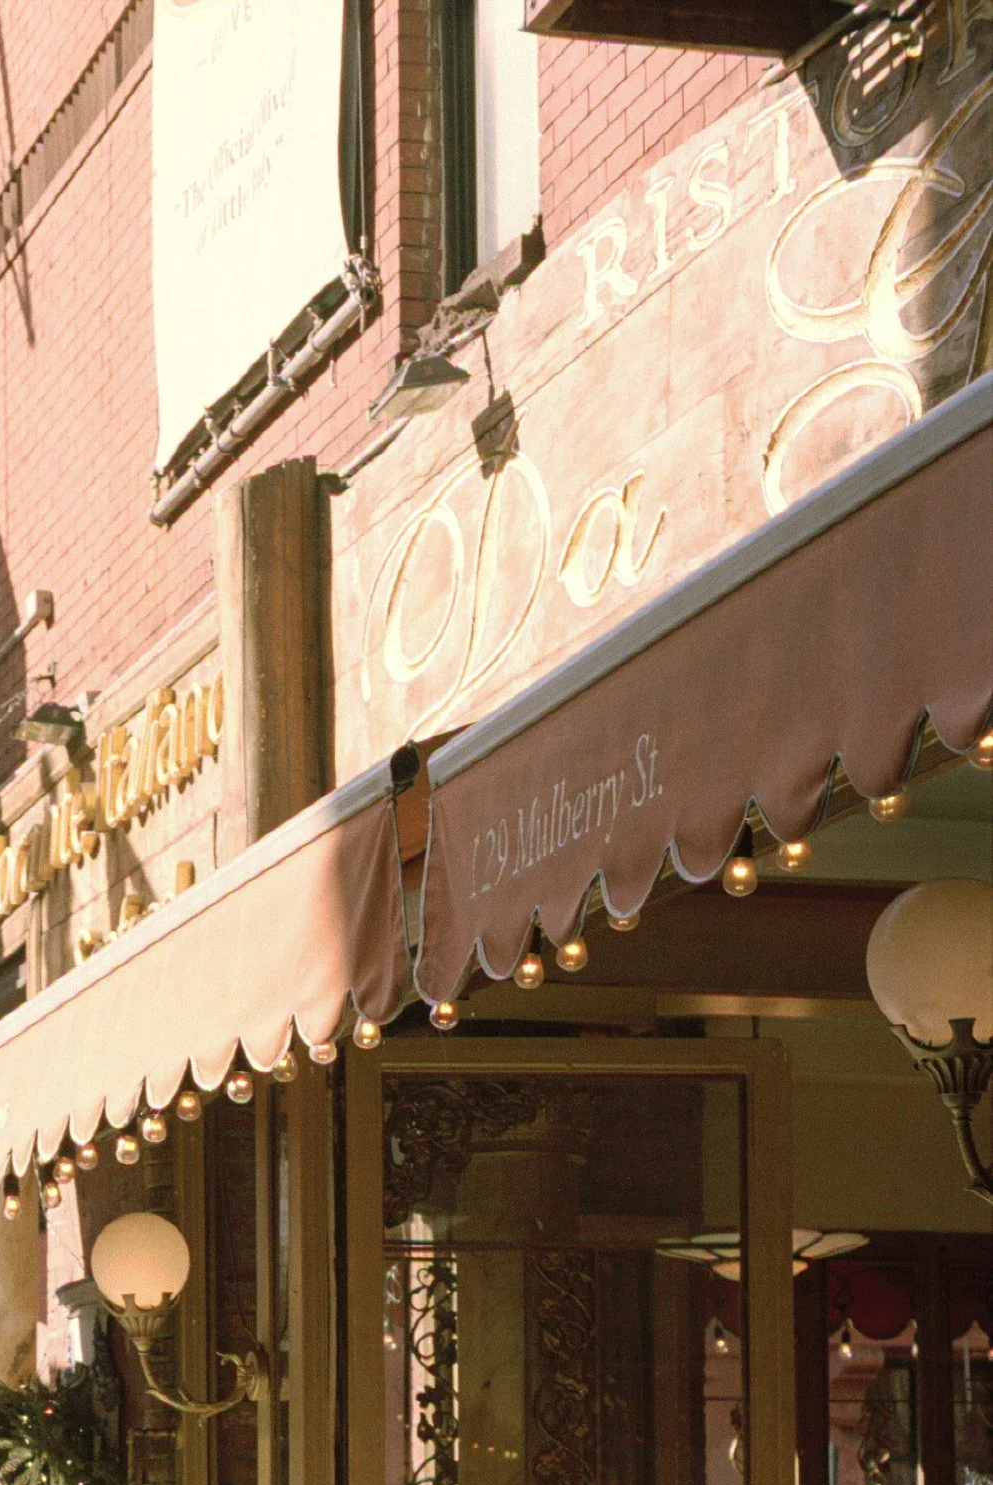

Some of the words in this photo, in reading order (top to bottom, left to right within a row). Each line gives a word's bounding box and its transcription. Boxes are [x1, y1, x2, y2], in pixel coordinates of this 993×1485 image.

[361, 405, 668, 742] Da
[469, 818, 508, 900] 129
[512, 769, 625, 876] Mulberry
[631, 733, 663, 807] St.
